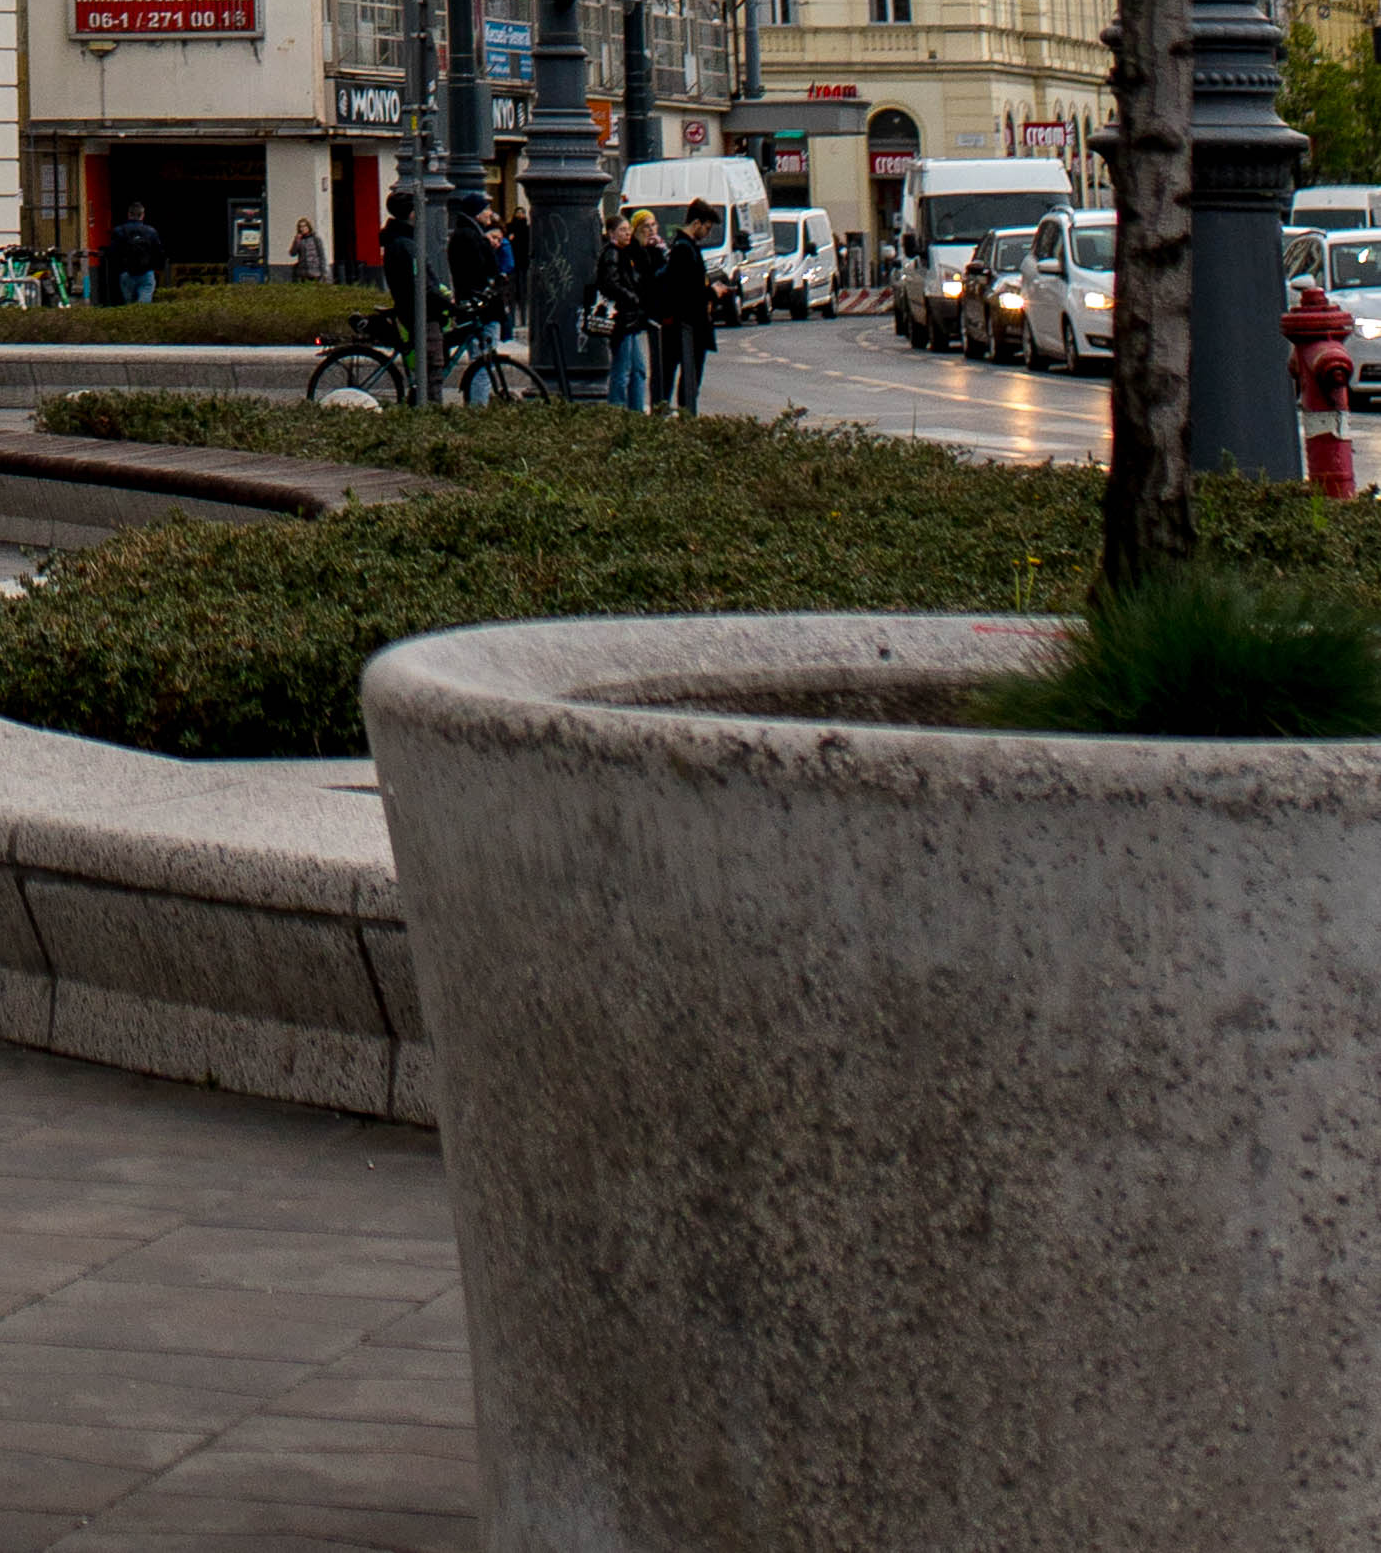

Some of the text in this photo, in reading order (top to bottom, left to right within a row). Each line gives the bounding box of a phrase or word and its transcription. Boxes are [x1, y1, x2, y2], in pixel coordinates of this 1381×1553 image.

[88, 11, 130, 28] 06-1
[148, 11, 184, 27] 271
[190, 11, 216, 27] 00
[492, 97, 515, 130] NYO
